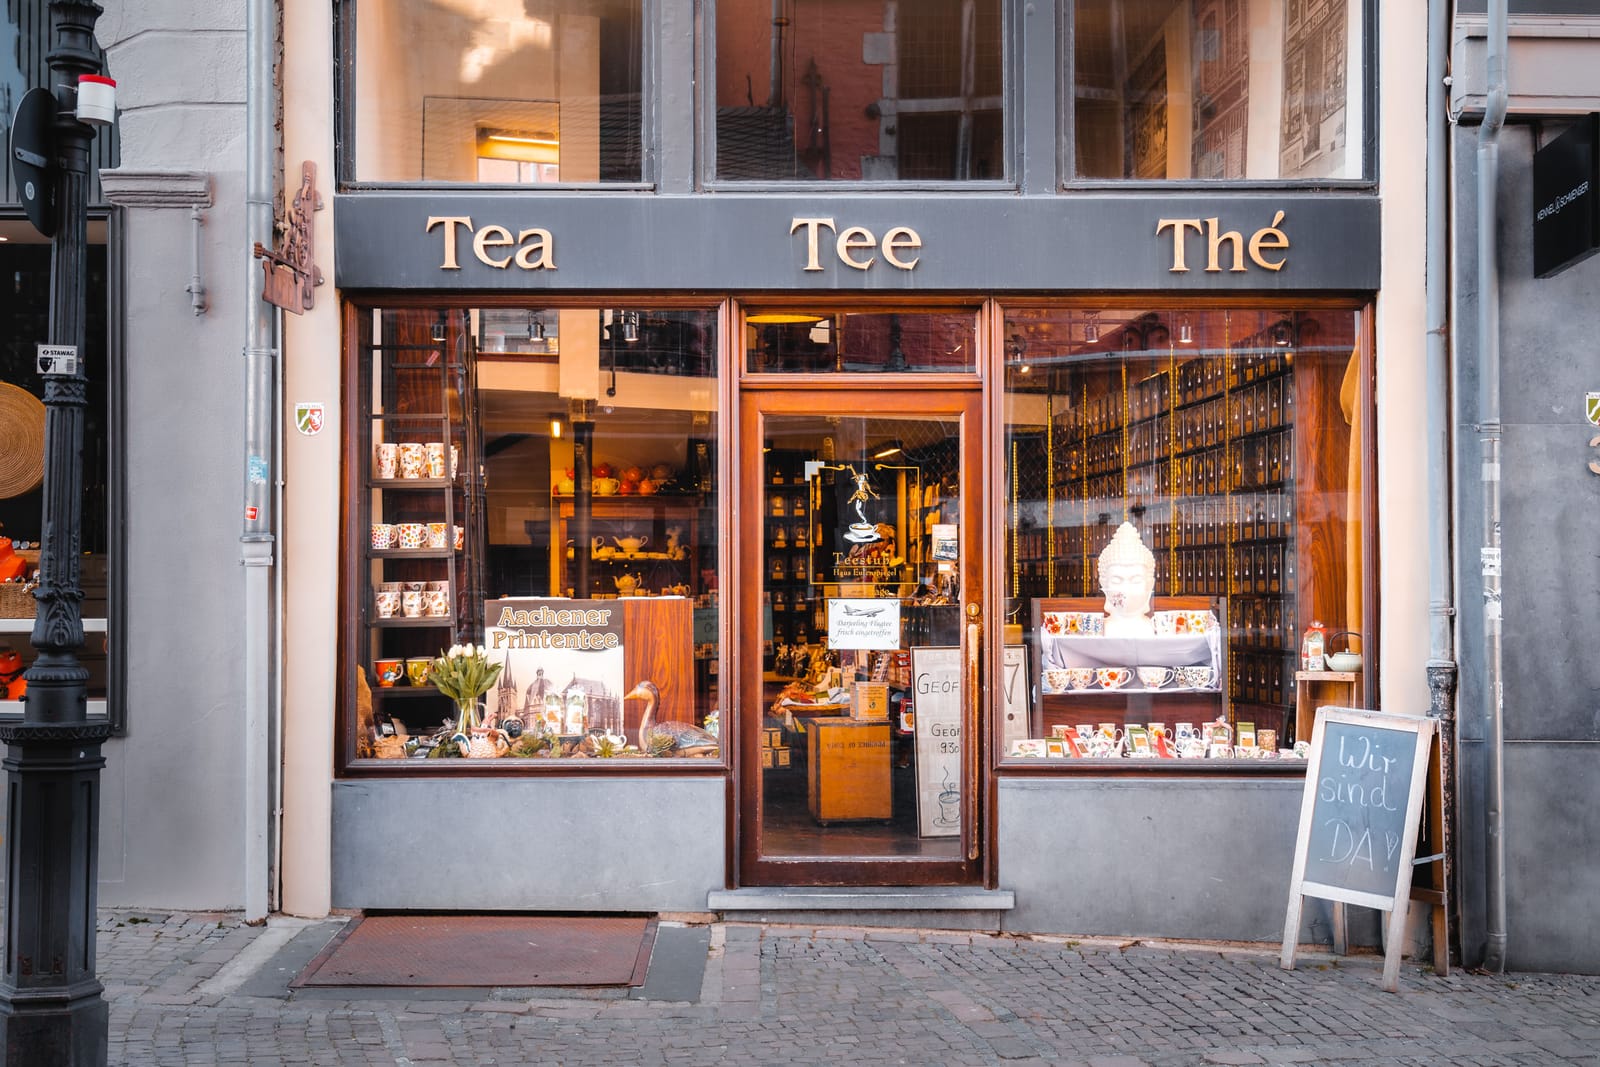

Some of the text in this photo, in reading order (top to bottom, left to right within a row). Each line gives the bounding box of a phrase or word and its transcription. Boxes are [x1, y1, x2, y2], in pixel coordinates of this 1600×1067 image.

[426, 216, 558, 269] Tea
[789, 217, 922, 271] Tee
[1155, 210, 1290, 272] Thé
[833, 552, 892, 565] Teestub
[497, 605, 612, 627] Aachener
[492, 629, 619, 650] Printentee
[1340, 736, 1397, 773] Wir
[1320, 774, 1397, 811] sind
